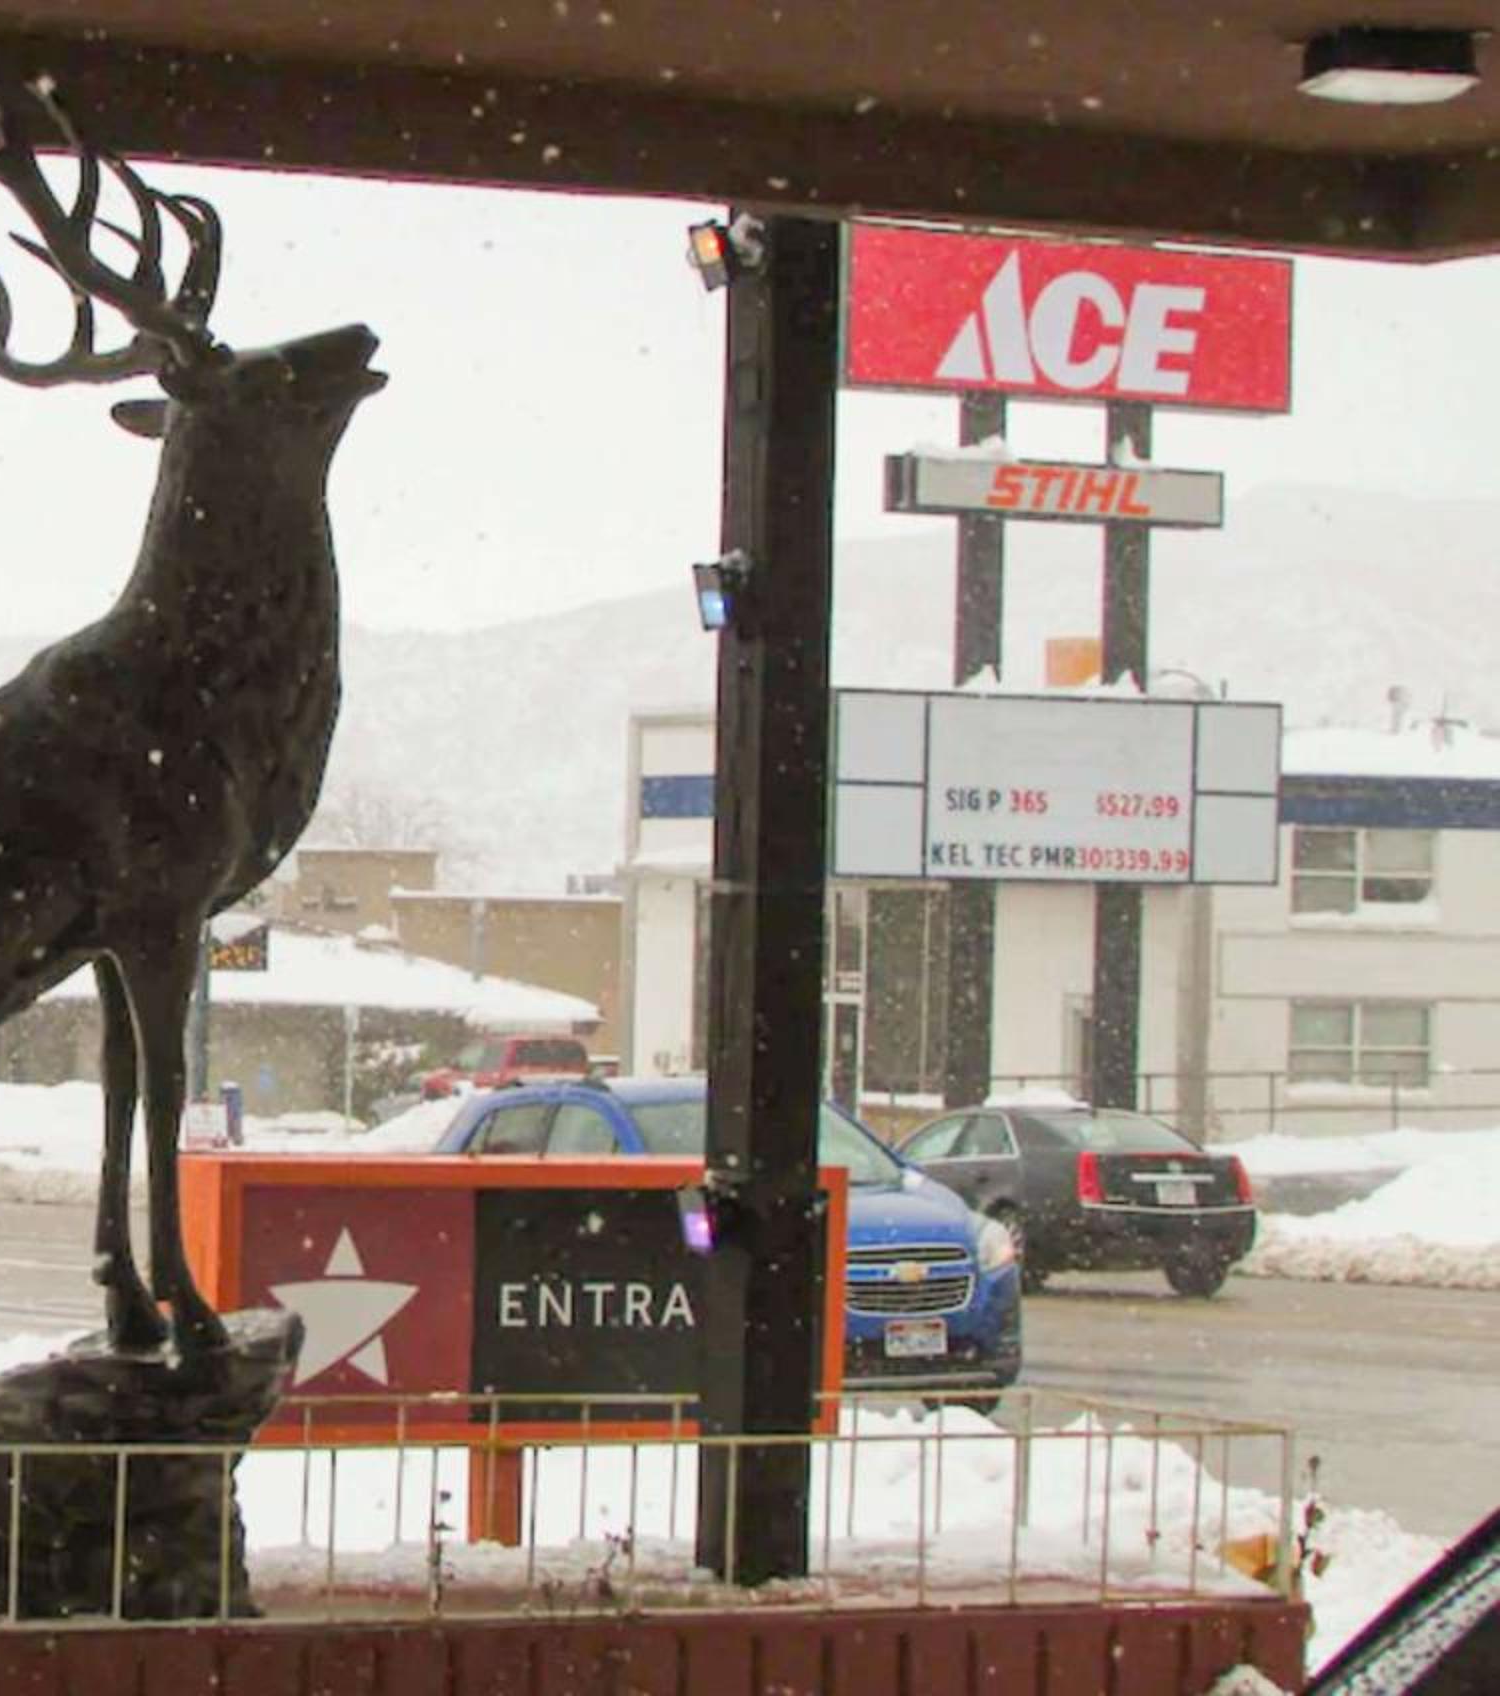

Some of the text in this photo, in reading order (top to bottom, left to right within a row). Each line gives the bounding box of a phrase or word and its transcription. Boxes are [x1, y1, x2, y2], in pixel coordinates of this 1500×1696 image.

[934, 248, 1206, 397] ACE
[986, 464, 1152, 516] STIHL
[946, 788, 981, 812] SIG
[988, 788, 1001, 812] P
[1010, 789, 1049, 814] 365
[931, 842, 973, 867] KEL
[984, 844, 1023, 868] TEC
[500, 1282, 695, 1327] ENTRA
